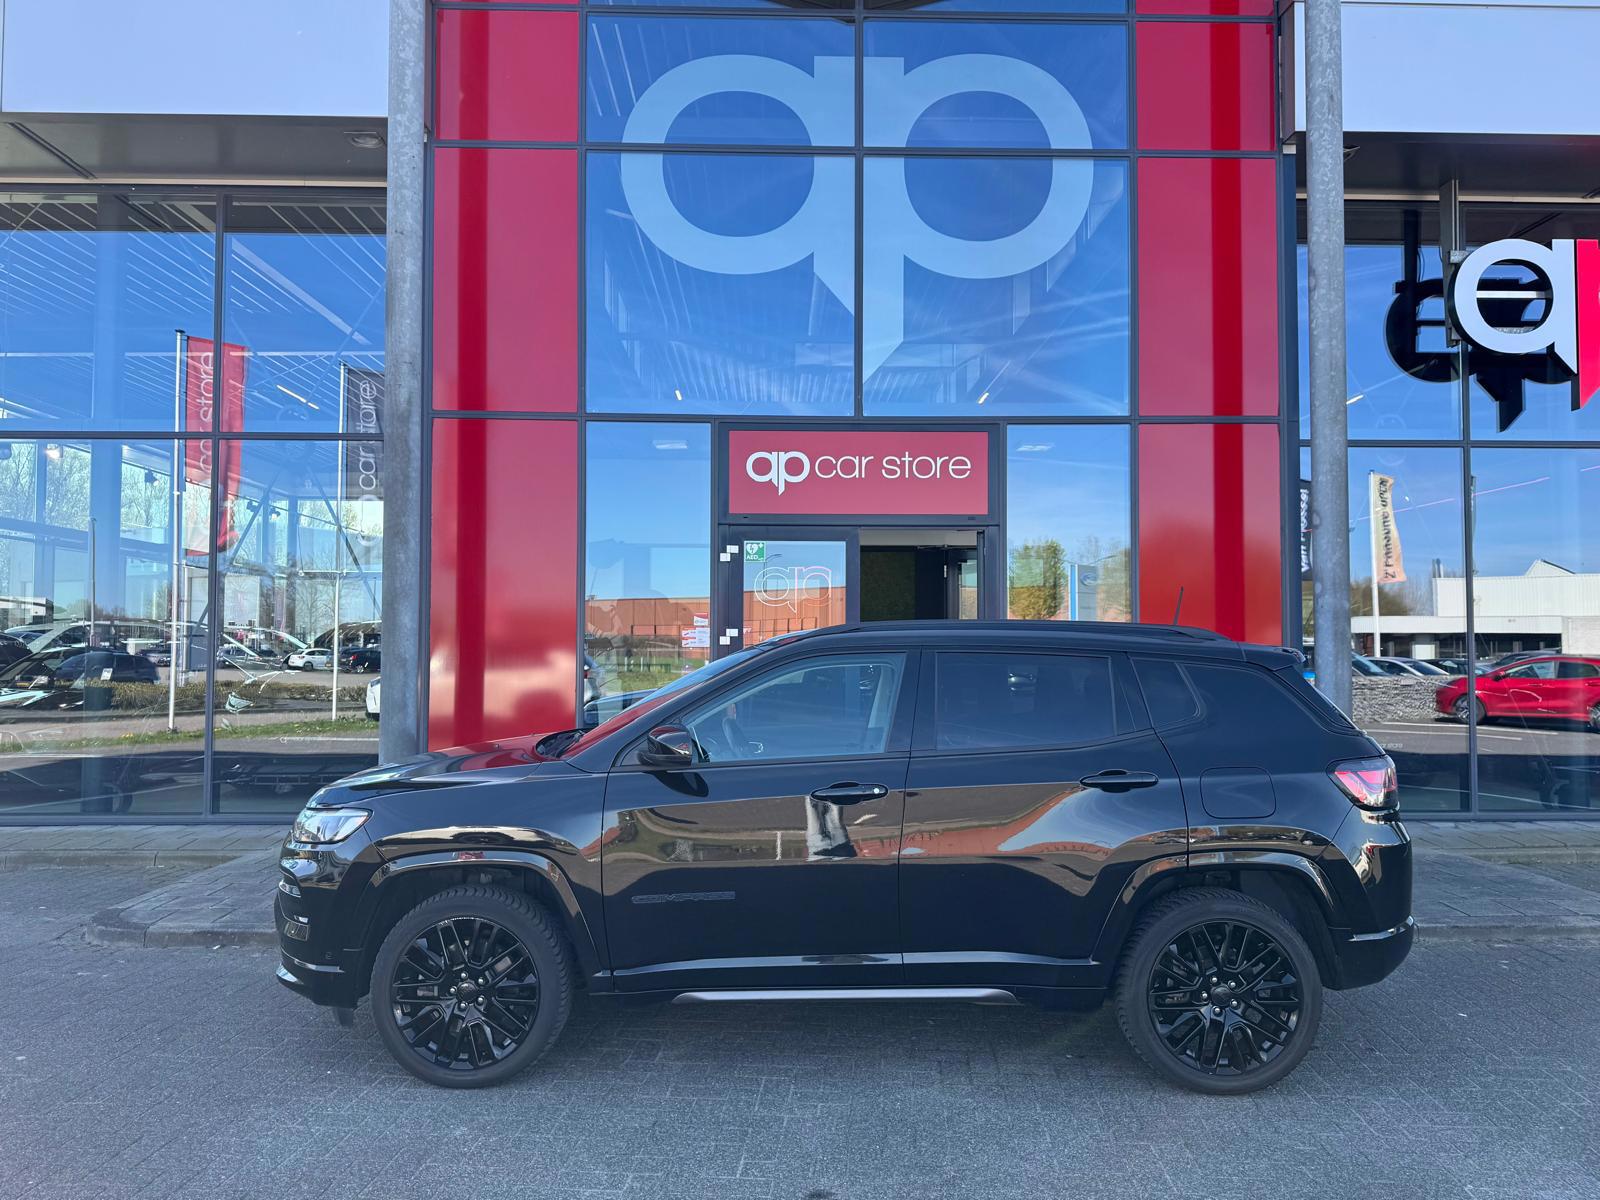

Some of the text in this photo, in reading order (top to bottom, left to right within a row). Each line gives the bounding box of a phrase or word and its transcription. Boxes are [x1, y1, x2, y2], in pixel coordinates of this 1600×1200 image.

[620, 53, 1094, 385] ap
[746, 451, 971, 496] ap car store
